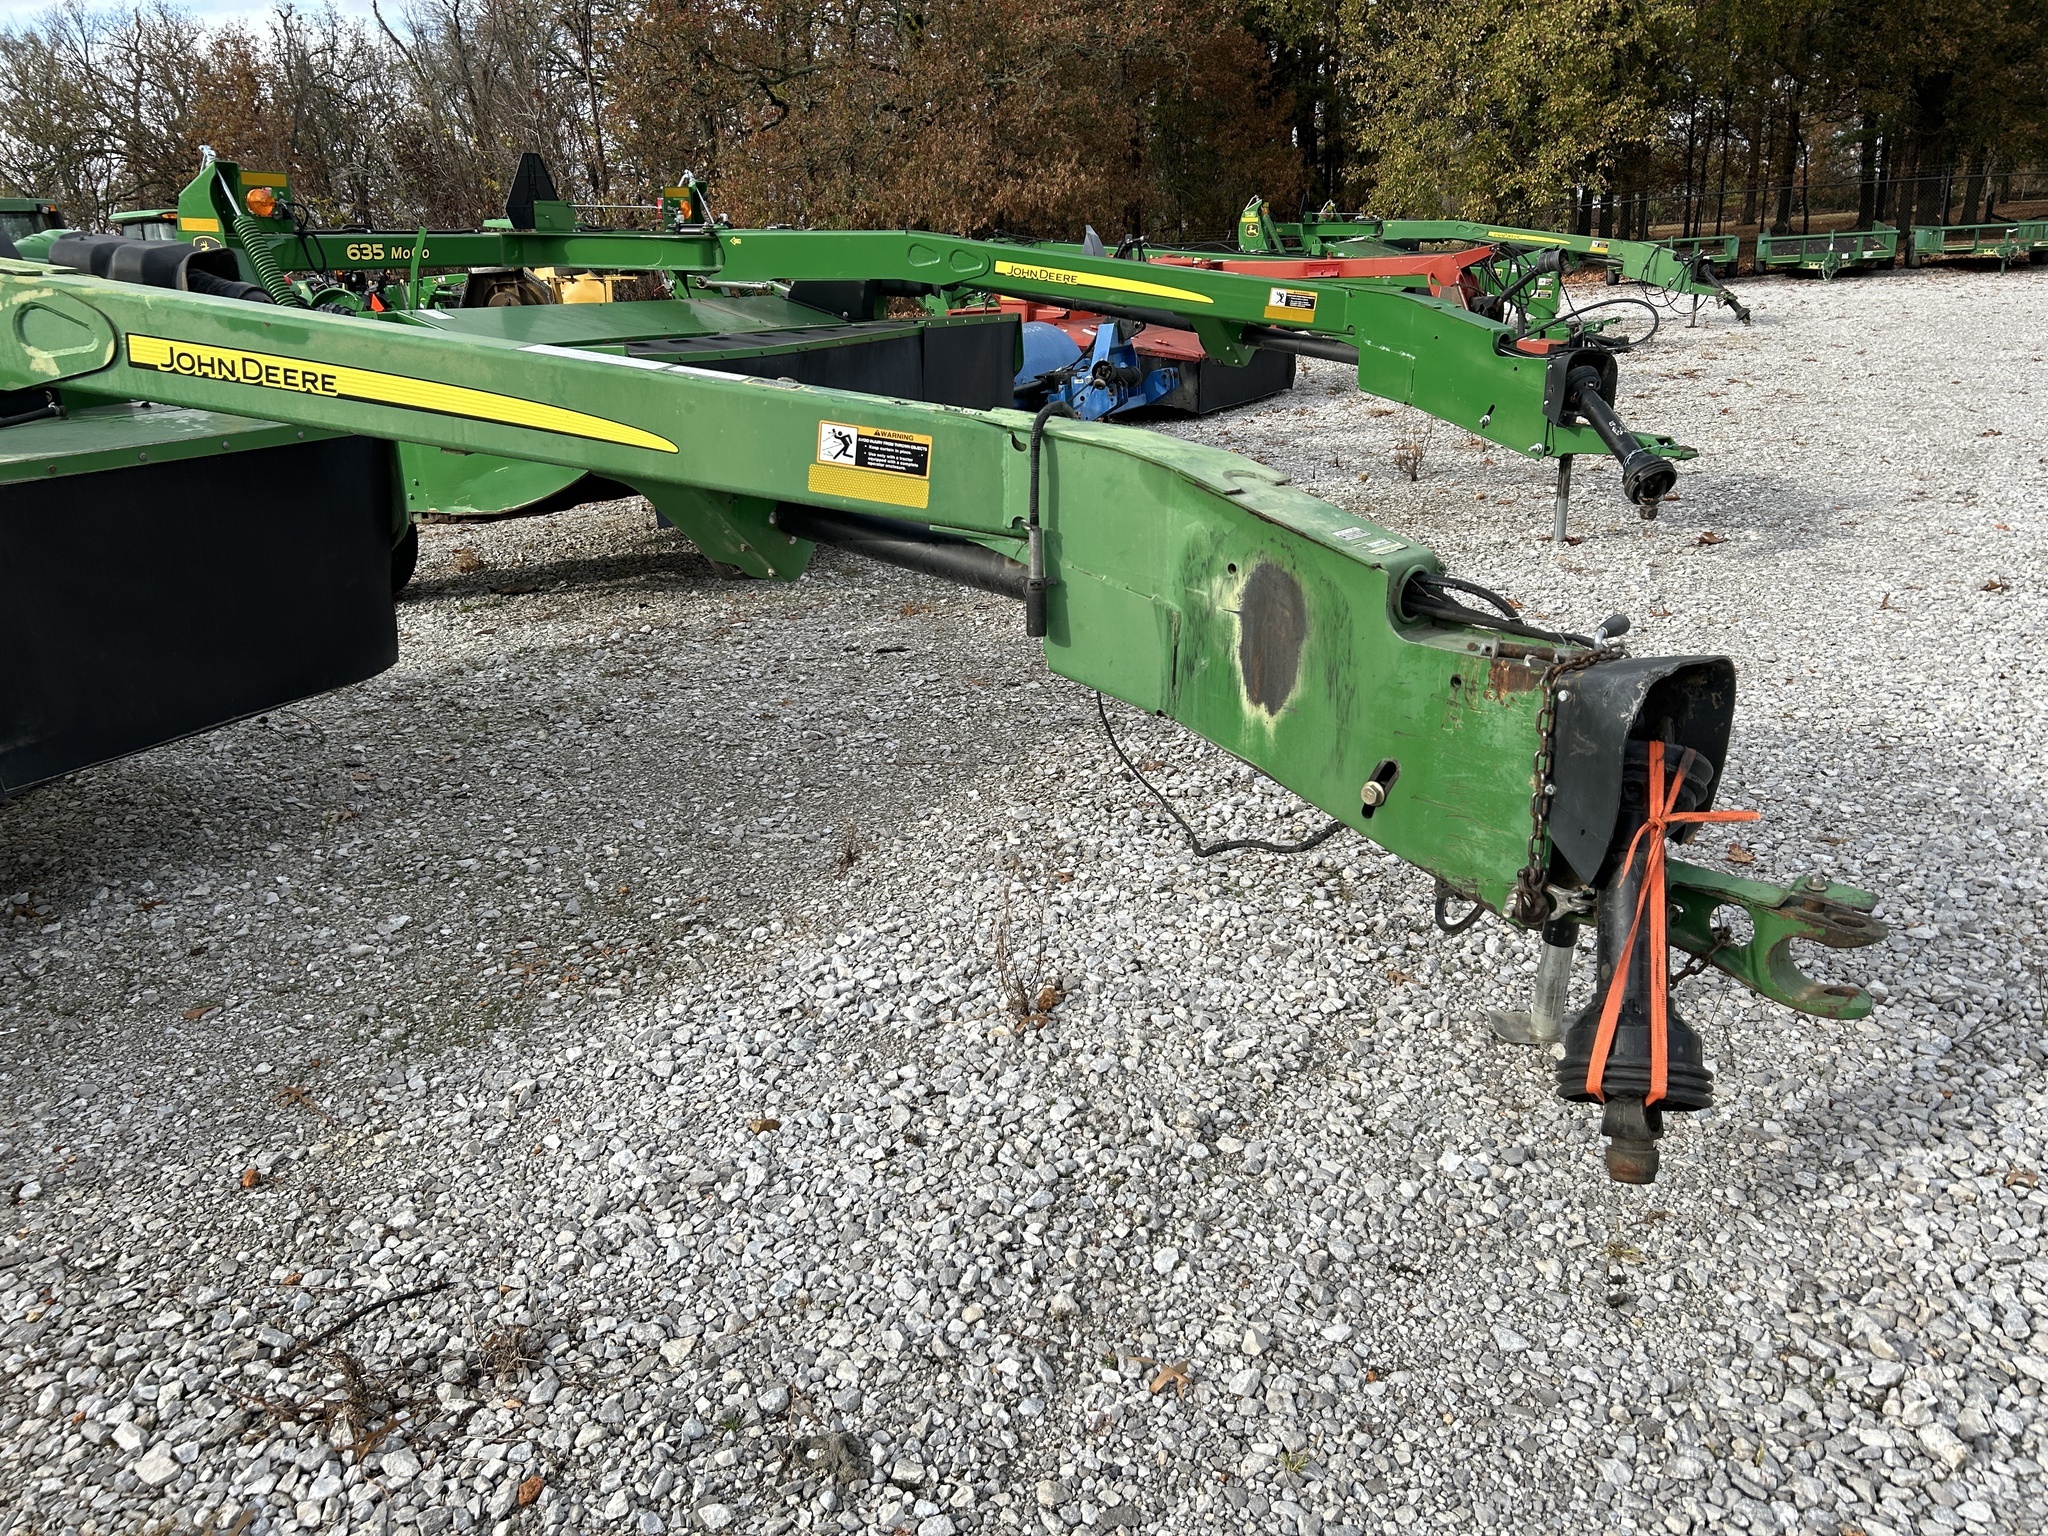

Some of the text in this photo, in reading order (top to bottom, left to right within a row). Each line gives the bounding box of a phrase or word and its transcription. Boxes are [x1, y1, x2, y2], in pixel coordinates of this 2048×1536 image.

[346, 243, 385, 261] 635
[1007, 265, 1078, 283] JOHN DEERE
[160, 346, 338, 393] JOHN DEERE
[881, 431, 914, 441] WARNING
